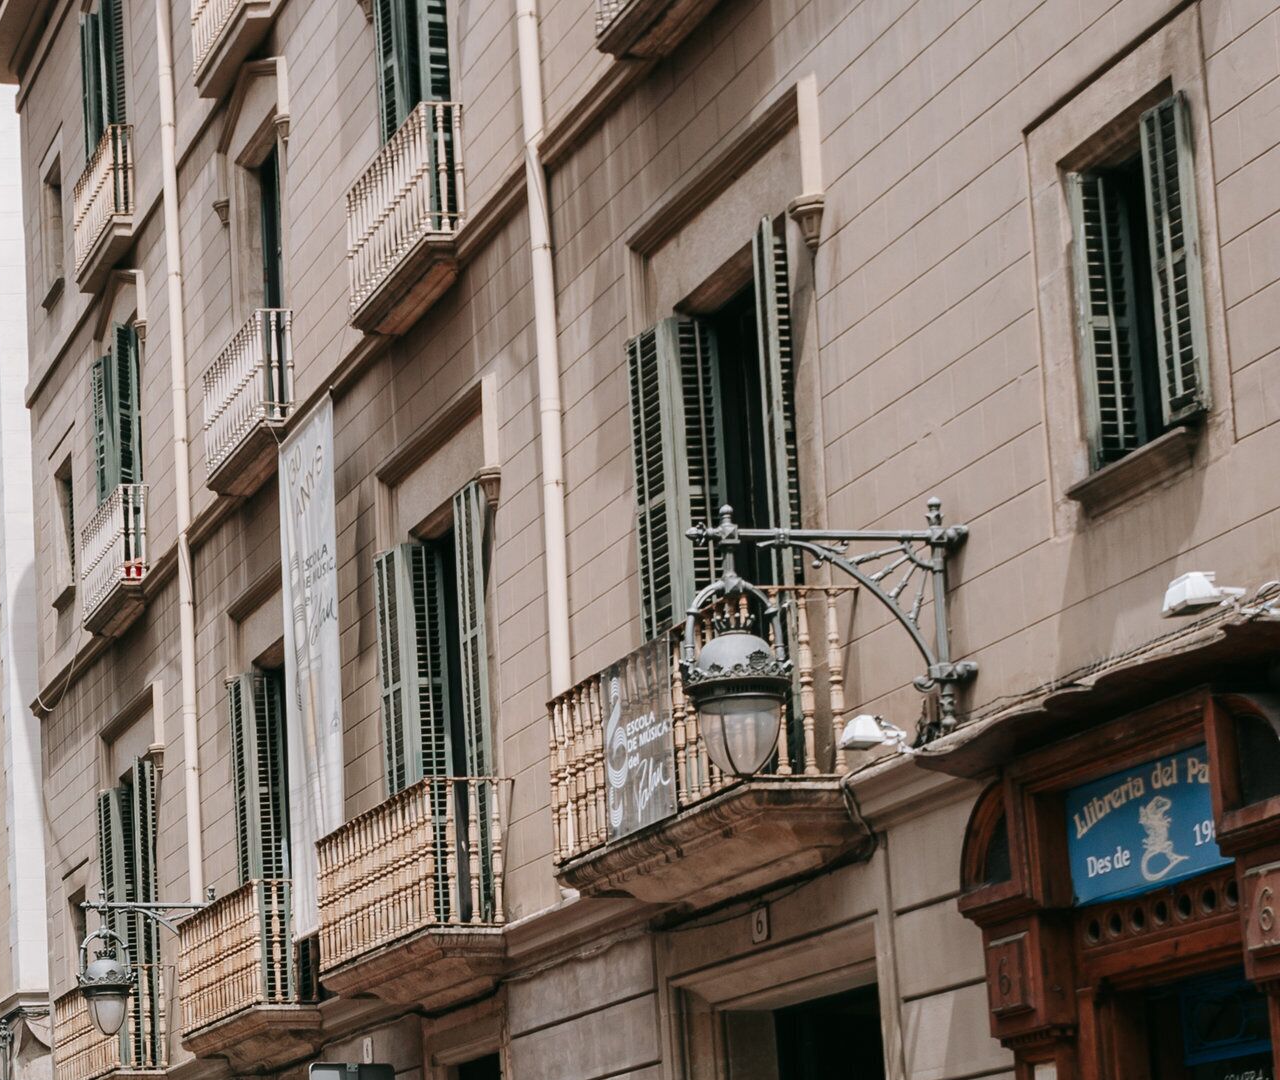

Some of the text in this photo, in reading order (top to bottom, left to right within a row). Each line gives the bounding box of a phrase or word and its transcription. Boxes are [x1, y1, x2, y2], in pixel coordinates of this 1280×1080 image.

[295, 445, 322, 529] ANYS
[303, 543, 328, 572] SCOLA
[626, 711, 656, 737] ESCOLA
[627, 720, 670, 753] DE MÚSICA
[628, 752, 640, 769] del
[1073, 775, 1144, 840] Llibreria
[1151, 758, 1178, 789] del
[1256, 886, 1274, 931] 6
